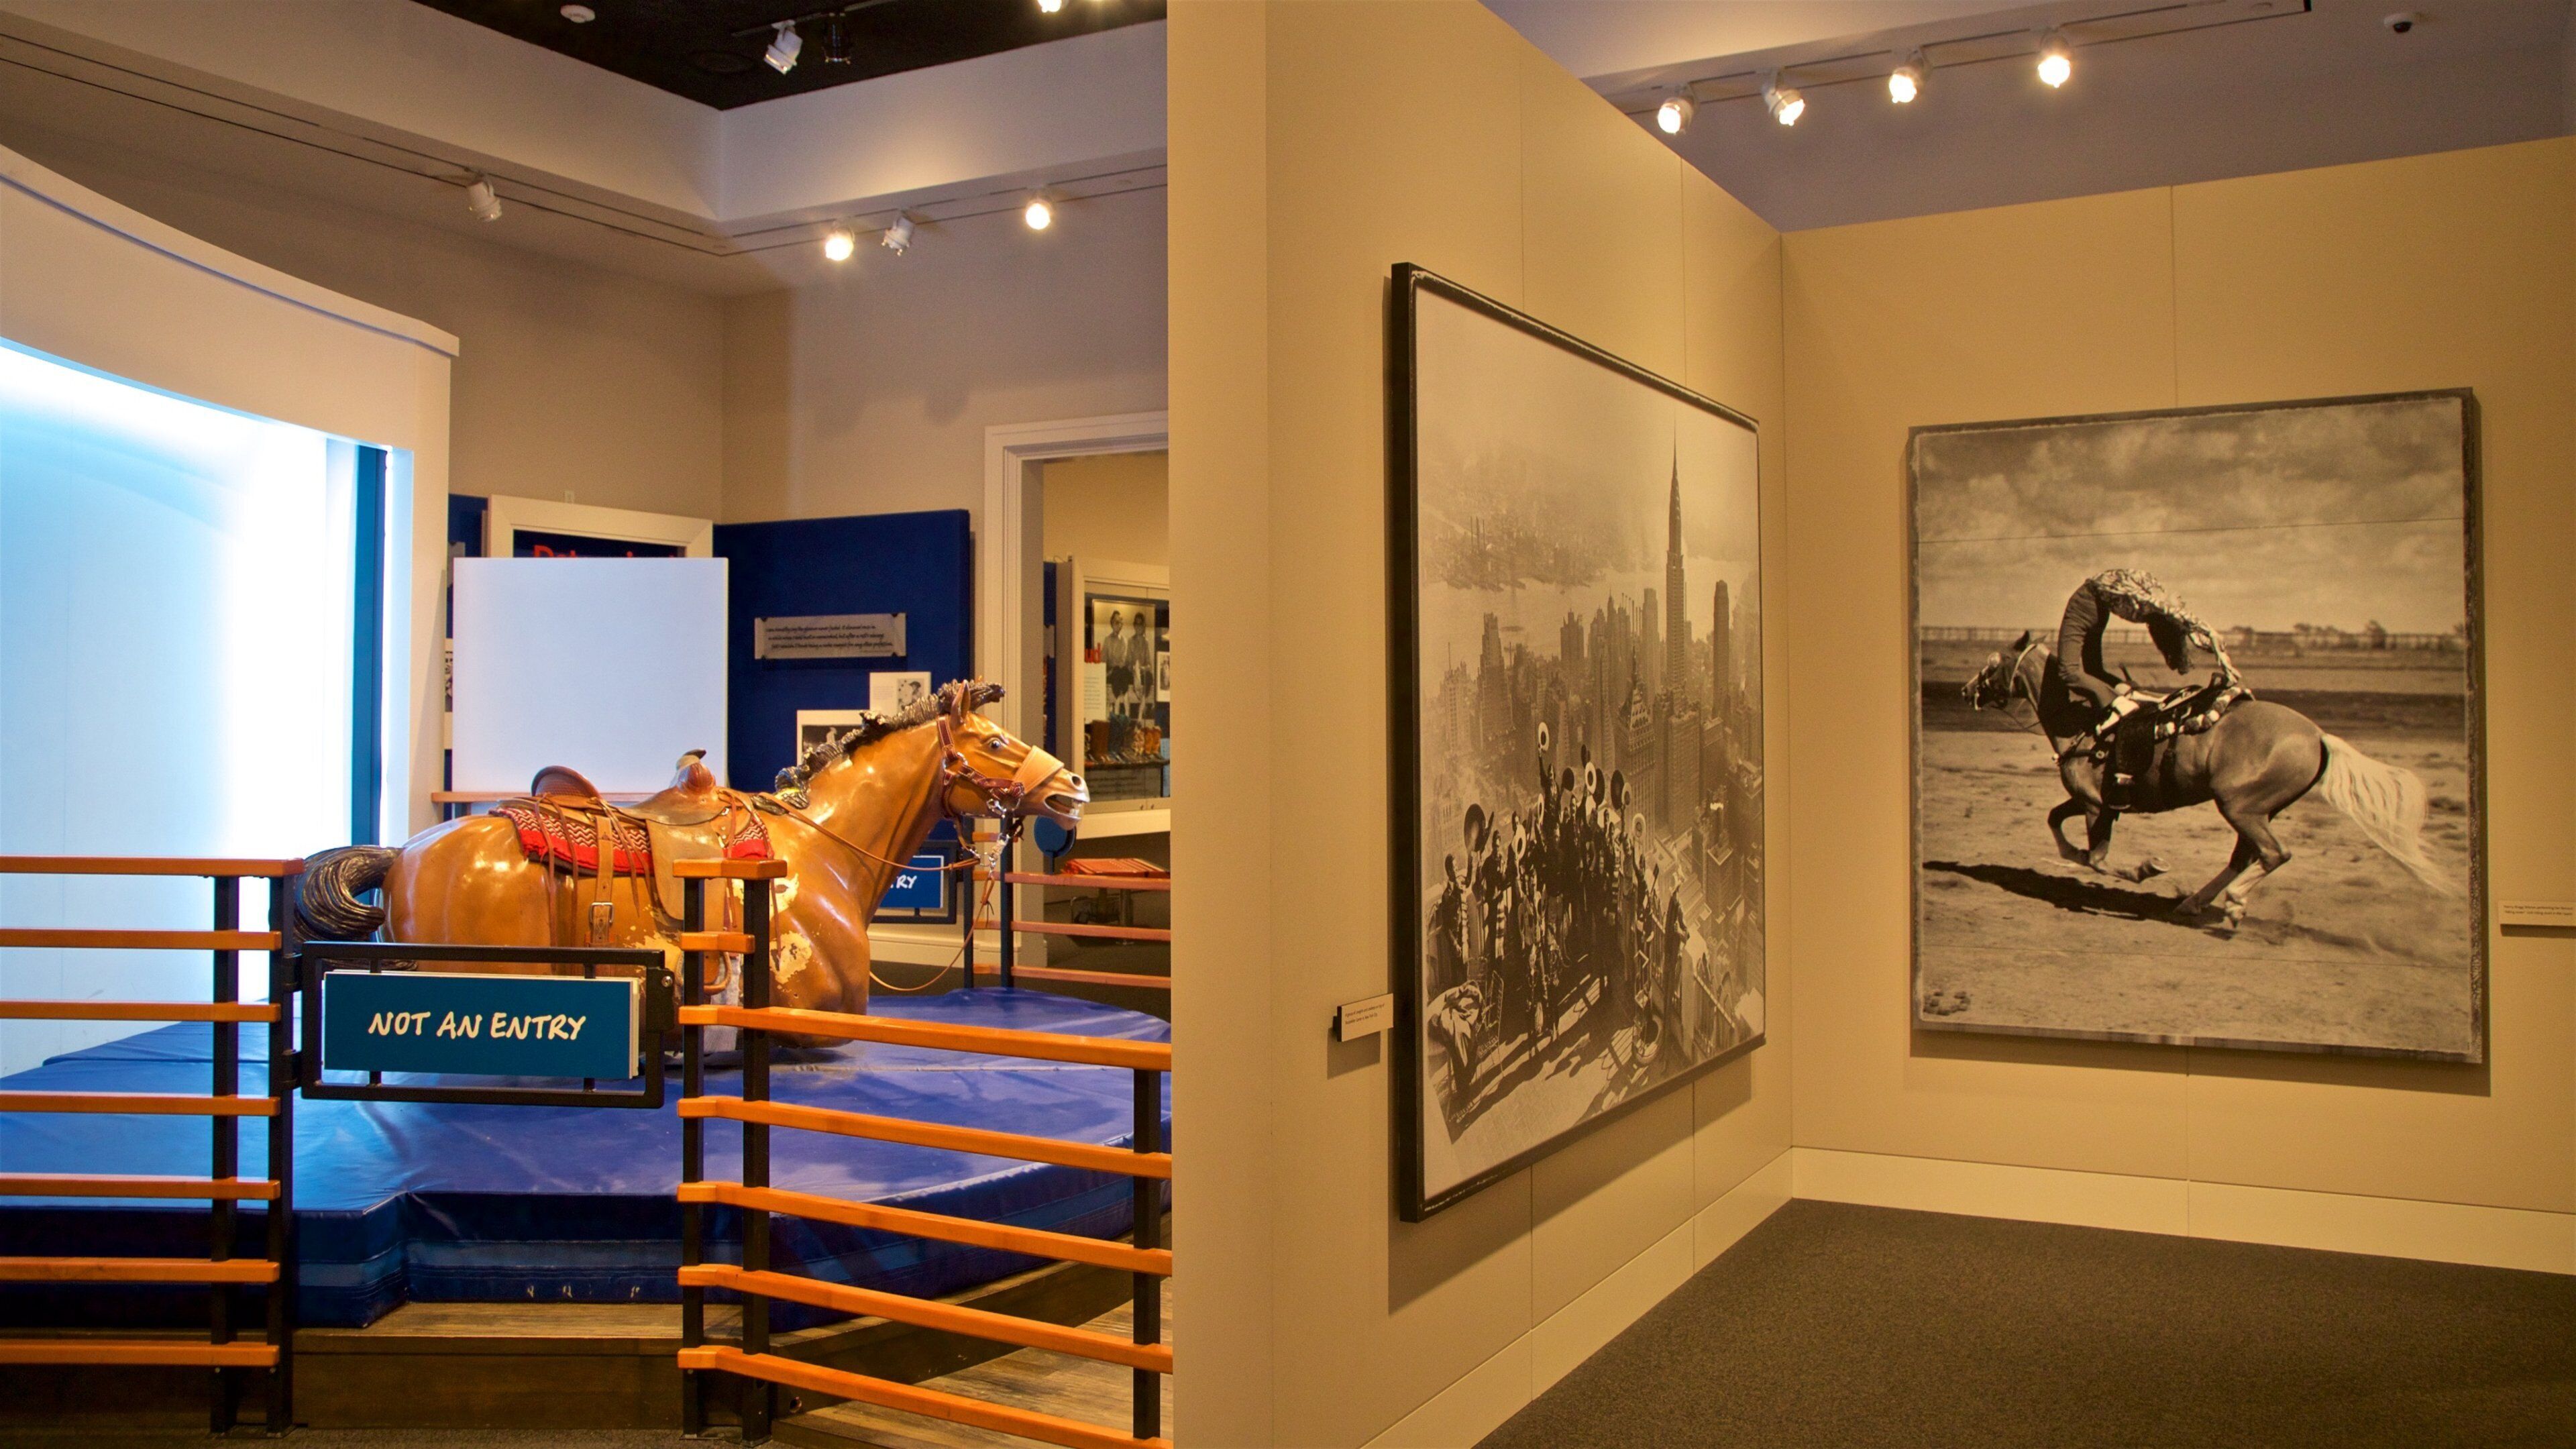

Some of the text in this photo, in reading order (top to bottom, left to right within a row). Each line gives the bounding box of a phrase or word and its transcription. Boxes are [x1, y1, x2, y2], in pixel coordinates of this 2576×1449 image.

[368, 1011, 586, 1040] NOT AN ENTRY
